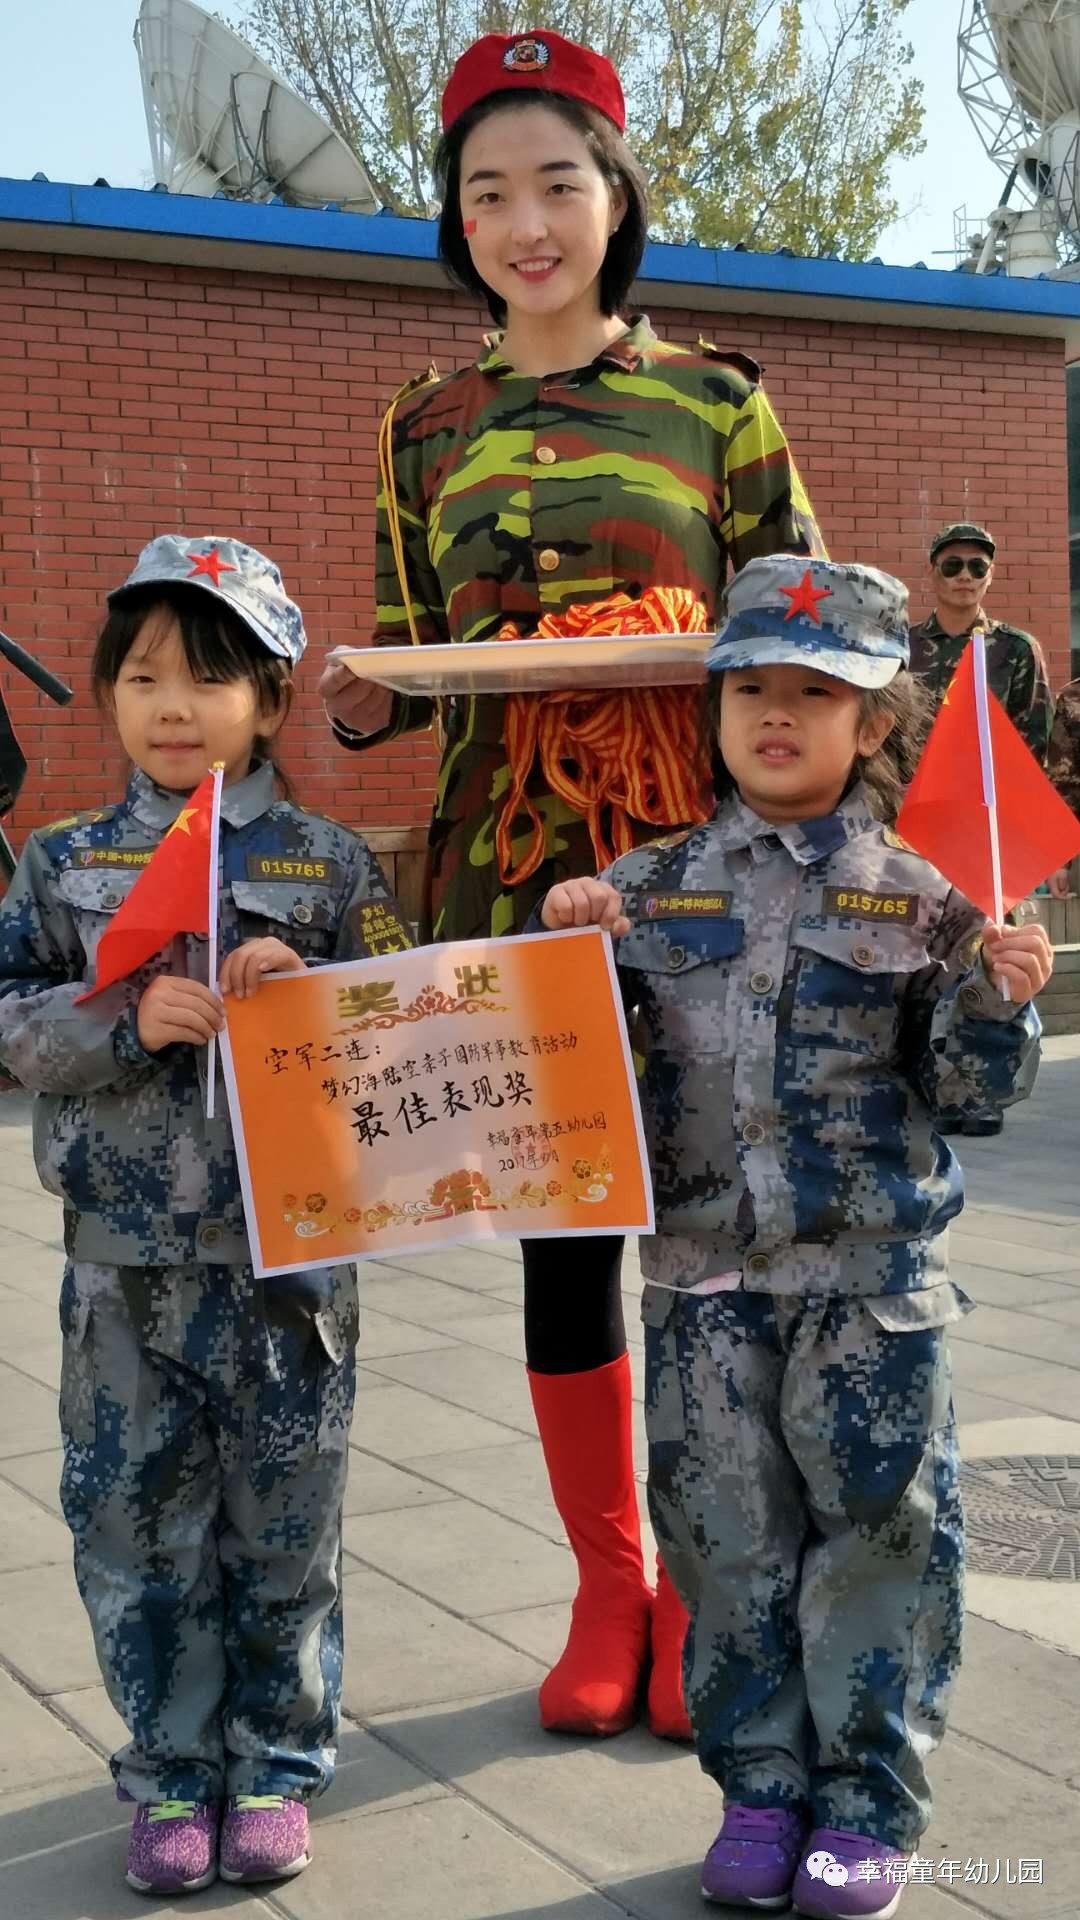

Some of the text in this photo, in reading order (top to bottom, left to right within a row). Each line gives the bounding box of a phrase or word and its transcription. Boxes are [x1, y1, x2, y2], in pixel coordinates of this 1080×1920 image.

[260, 860, 325, 879] 015765
[836, 893, 908, 915] 015765
[349, 1069, 534, 1147] 最佳表现奖
